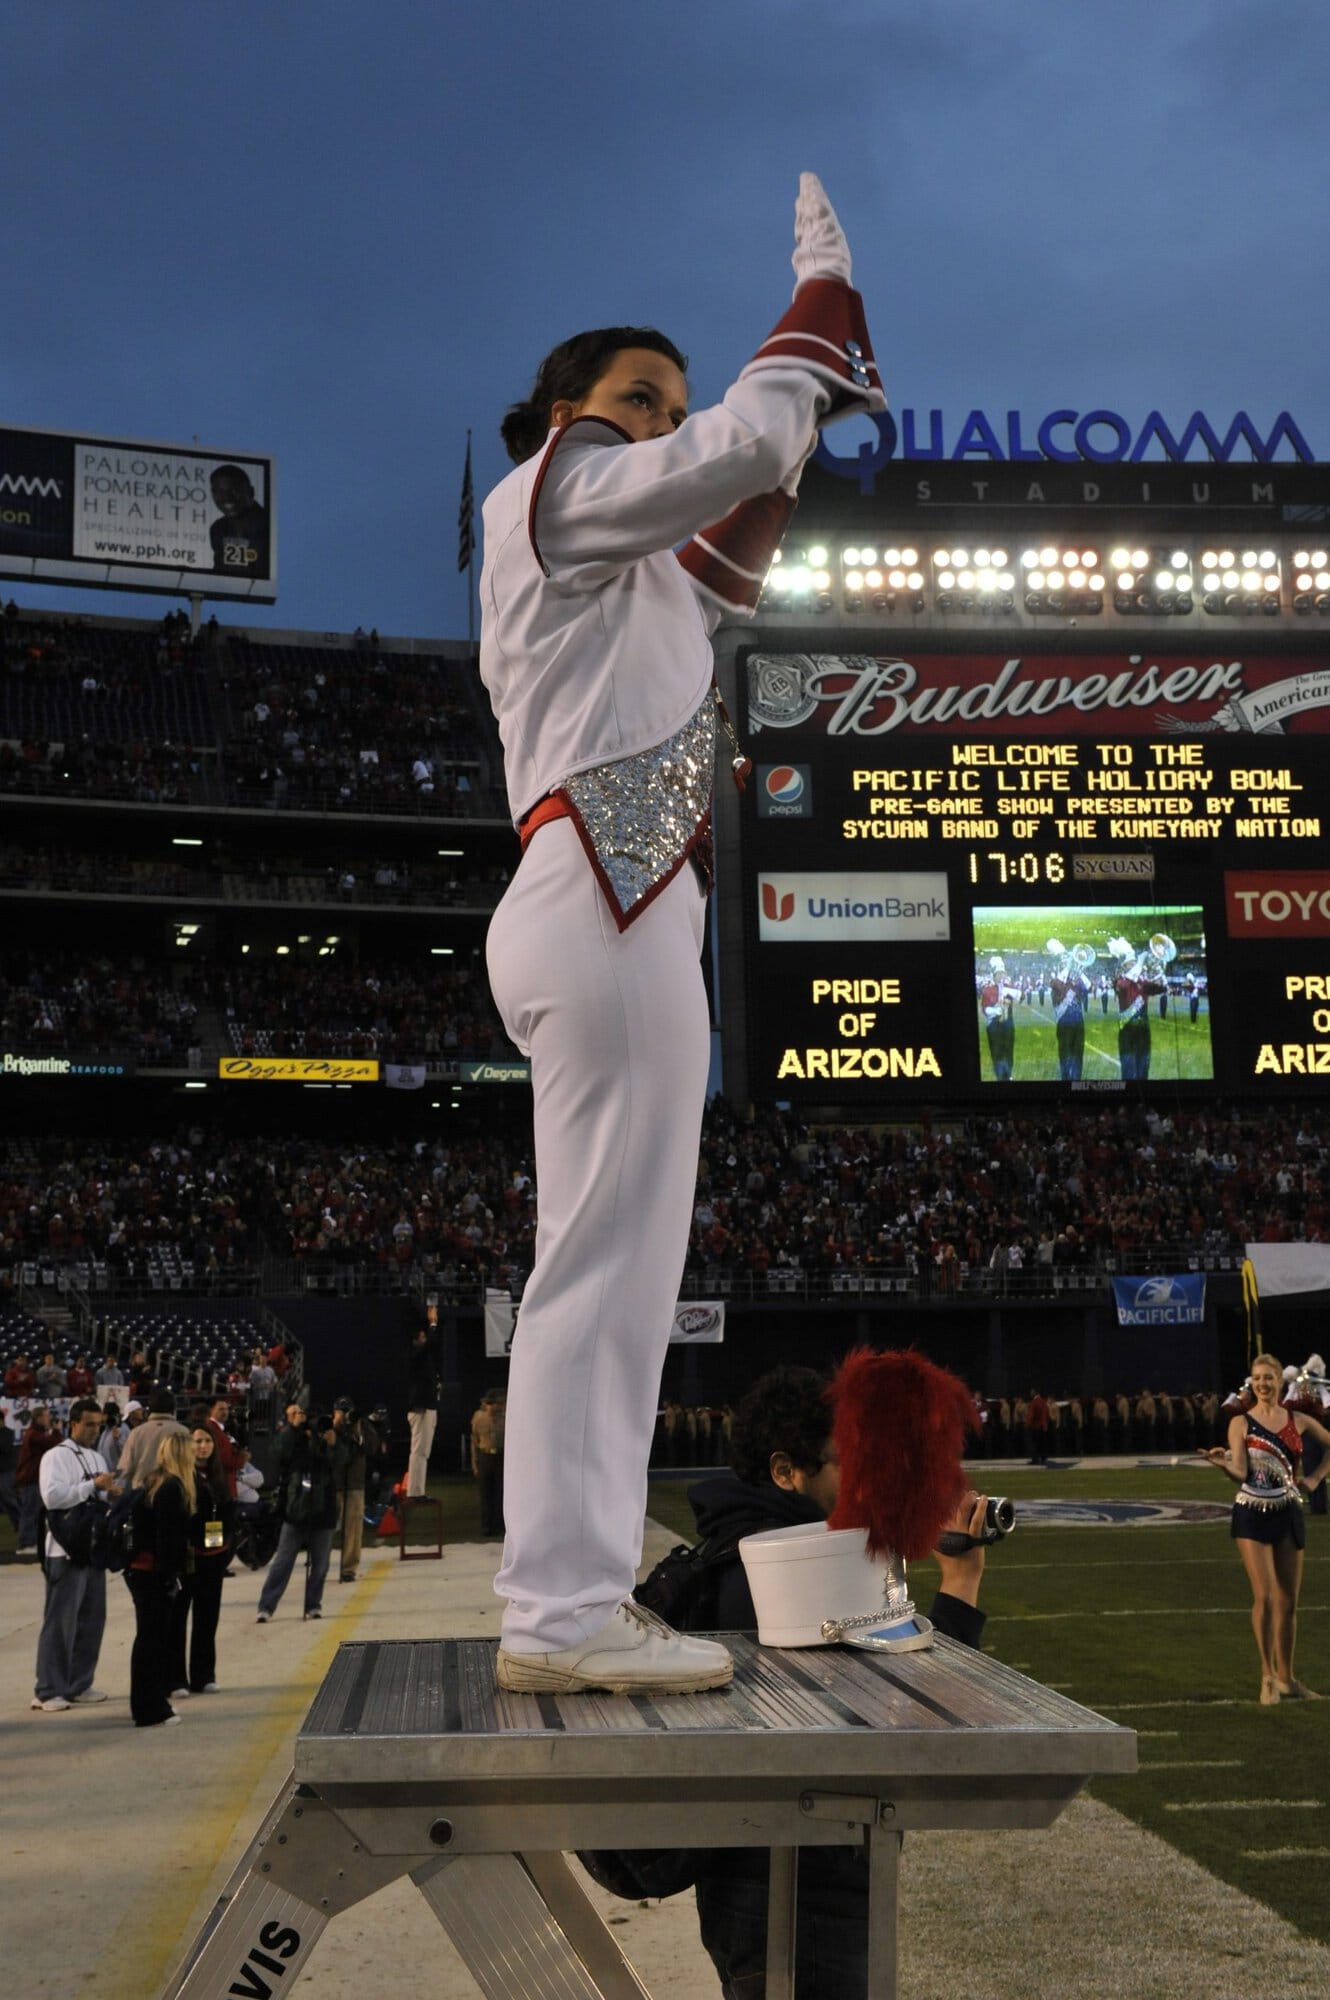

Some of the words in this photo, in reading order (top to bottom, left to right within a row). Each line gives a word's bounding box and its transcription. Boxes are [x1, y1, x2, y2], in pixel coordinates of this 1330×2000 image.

[814, 409, 1316, 496] QUALCOMM
[84, 454, 207, 483] PALOMAR
[84, 476, 207, 504] POMERADO
[916, 482, 1275, 502] STADIUM
[84, 498, 207, 525] HEALTH
[94, 540, 196, 564] www.pph.org
[224, 544, 248, 566] 21
[806, 655, 1243, 735] Budweiser
[953, 745, 1079, 766] WELCOME
[1096, 745, 1133, 766] TO
[1150, 744, 1204, 766] THE
[853, 770, 981, 791] PACIFIC
[998, 770, 1071, 791] LIFE
[1087, 770, 1214, 791] HOLIDAY
[1230, 769, 1304, 790] BOWL
[769, 803, 803, 816] pepsi
[870, 798, 984, 815] PRE-GAME
[997, 798, 1054, 815] SHOW
[1067, 798, 1194, 814] PRESENTED
[1206, 797, 1235, 813] BY
[1248, 797, 1291, 813] THE
[843, 820, 929, 838] SYCUAN
[942, 820, 999, 838] BAND
[1012, 820, 1041, 838] OF
[1054, 820, 1097, 838] THE
[1235, 818, 1321, 837] NATION
[969, 853, 1065, 883] 17:06
[1075, 860, 1154, 874] SYCUAN
[808, 898, 945, 918] UnionBank
[812, 979, 901, 1004] PRIDE
[838, 1013, 876, 1037] OF
[4, 1053, 71, 1075] Brigantine
[71, 1065, 124, 1074] SEAFOOD
[301, 1060, 371, 1079] Pizza
[777, 1047, 943, 1078] ARIZONA
[484, 1067, 528, 1081] Degree
[1119, 1306, 1174, 1325] PACIFIC
[228, 1921, 300, 2000] VIS
